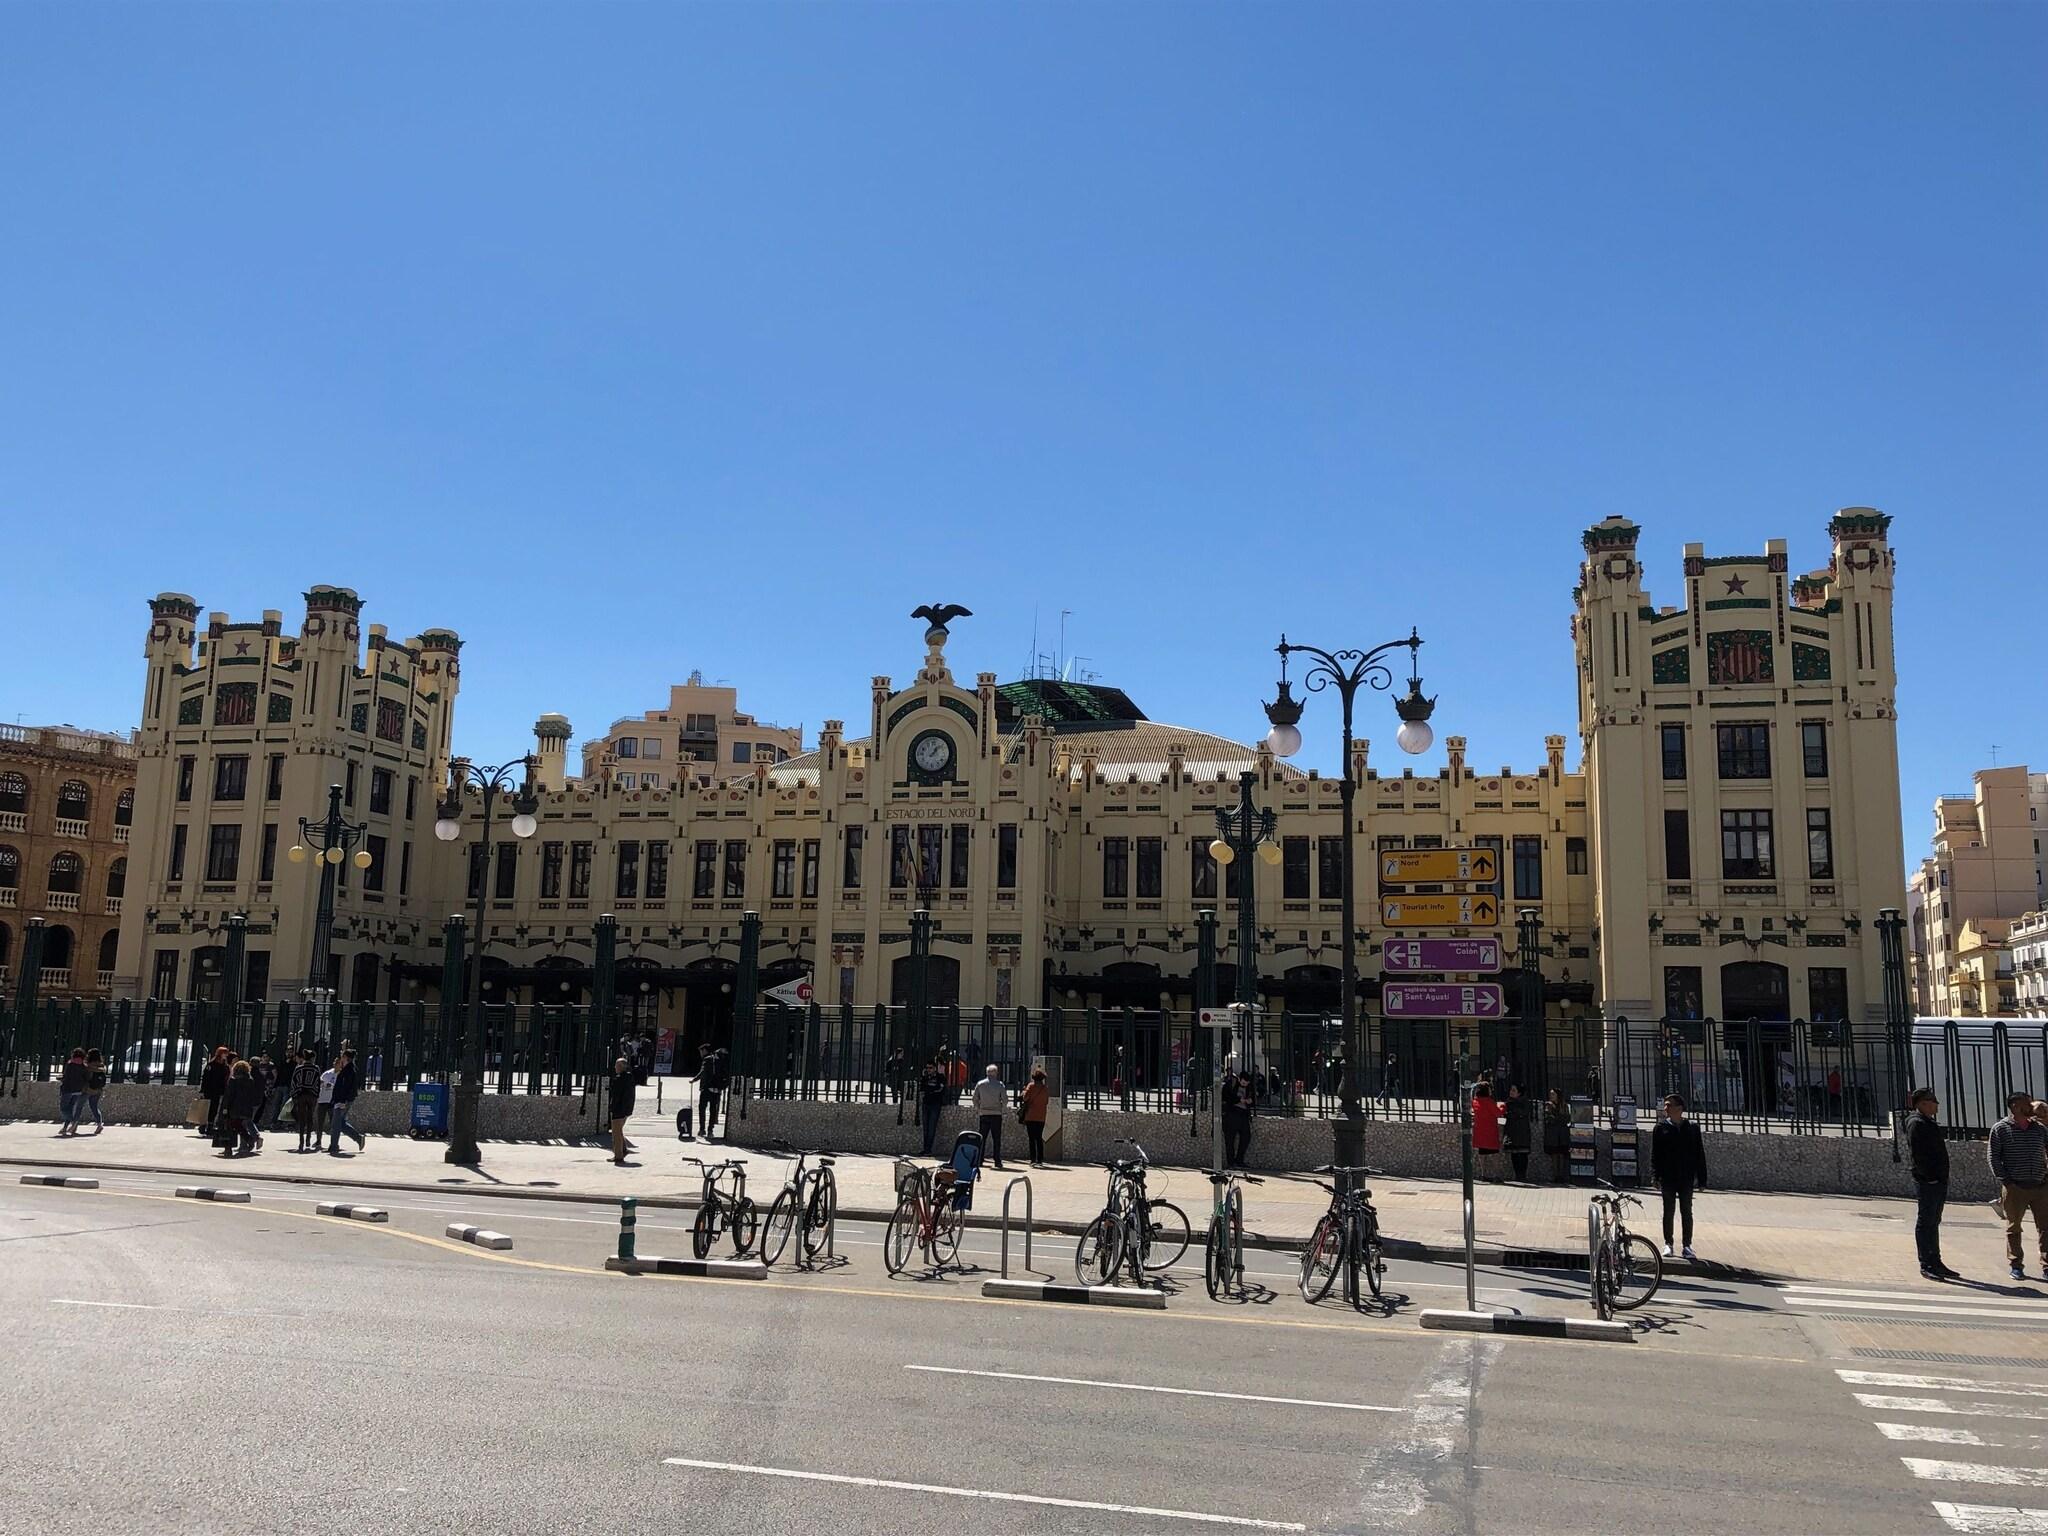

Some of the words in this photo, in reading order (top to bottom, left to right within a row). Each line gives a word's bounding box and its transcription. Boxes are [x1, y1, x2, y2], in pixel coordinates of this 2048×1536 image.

[886, 808, 925, 819] ESTACIO
[927, 808, 946, 818] DEL
[948, 807, 976, 818] NORD
[1425, 993, 1450, 1001] Agustí
